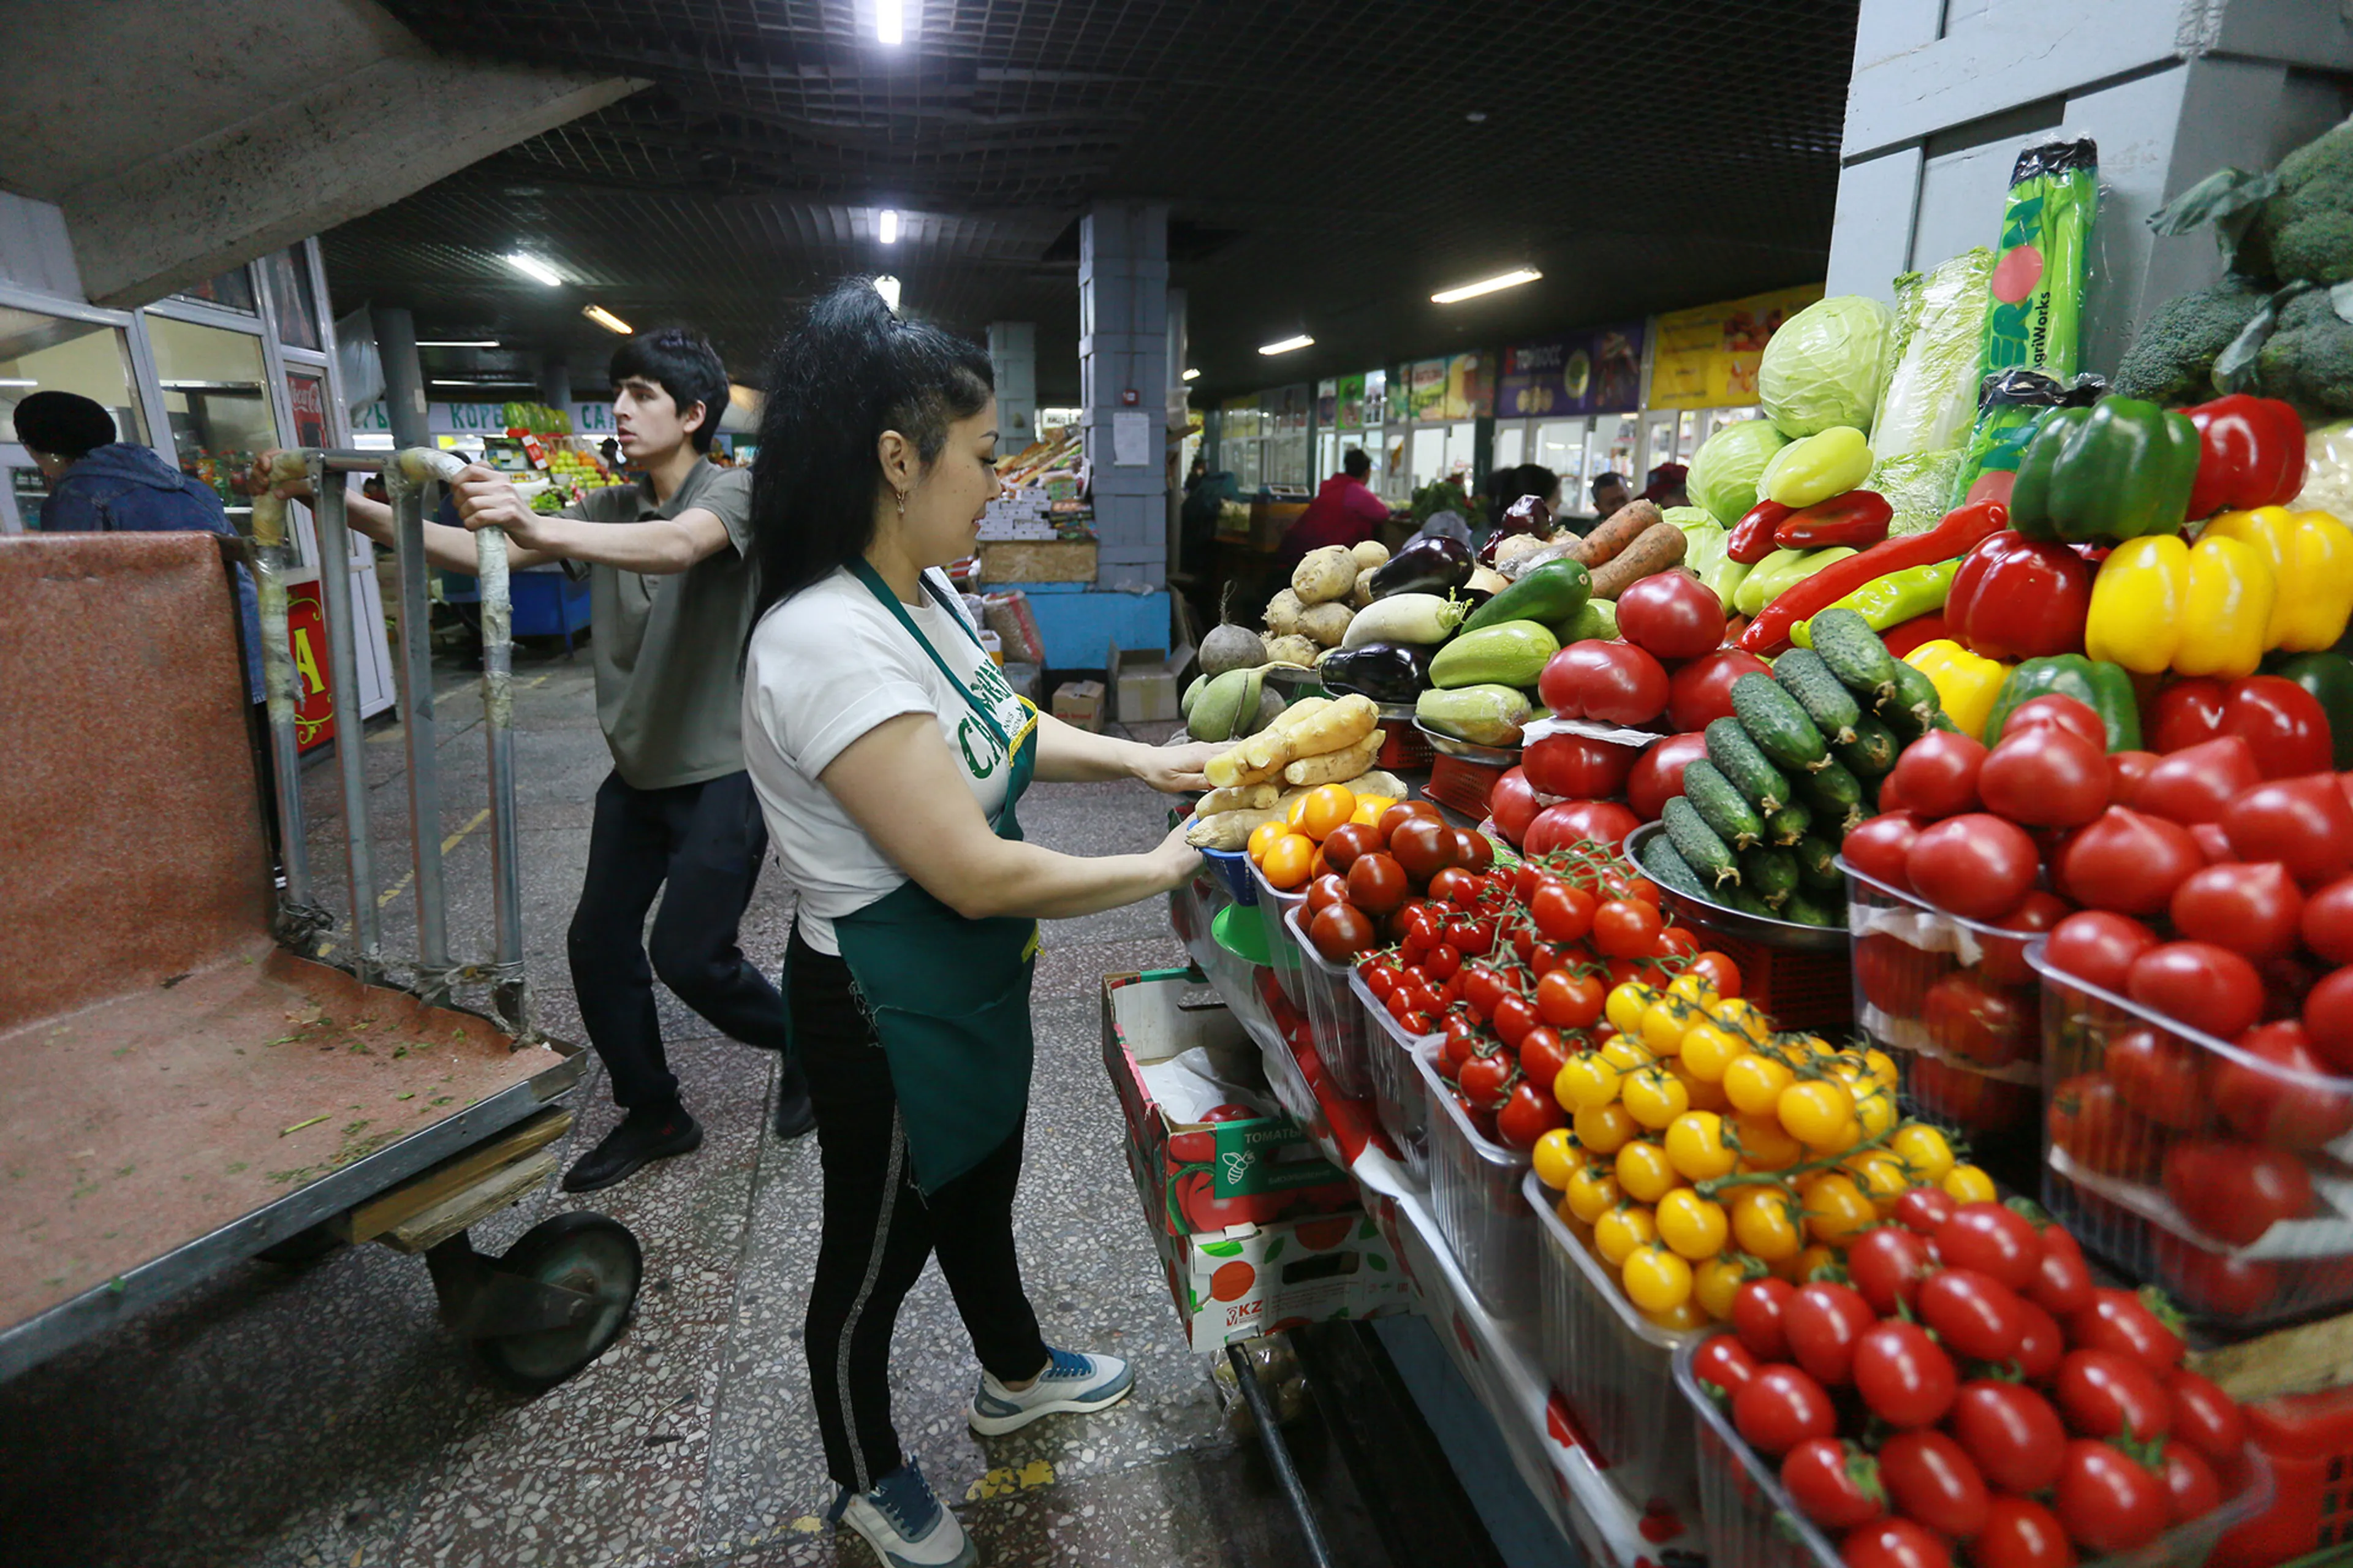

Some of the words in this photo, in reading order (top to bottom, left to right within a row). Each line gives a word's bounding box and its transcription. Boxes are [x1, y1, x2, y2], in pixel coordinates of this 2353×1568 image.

[450, 403, 504, 428] КОРЕ
[1245, 1128, 1302, 1143] ТОМАТЫ
[1238, 1300, 1264, 1317] KZ
